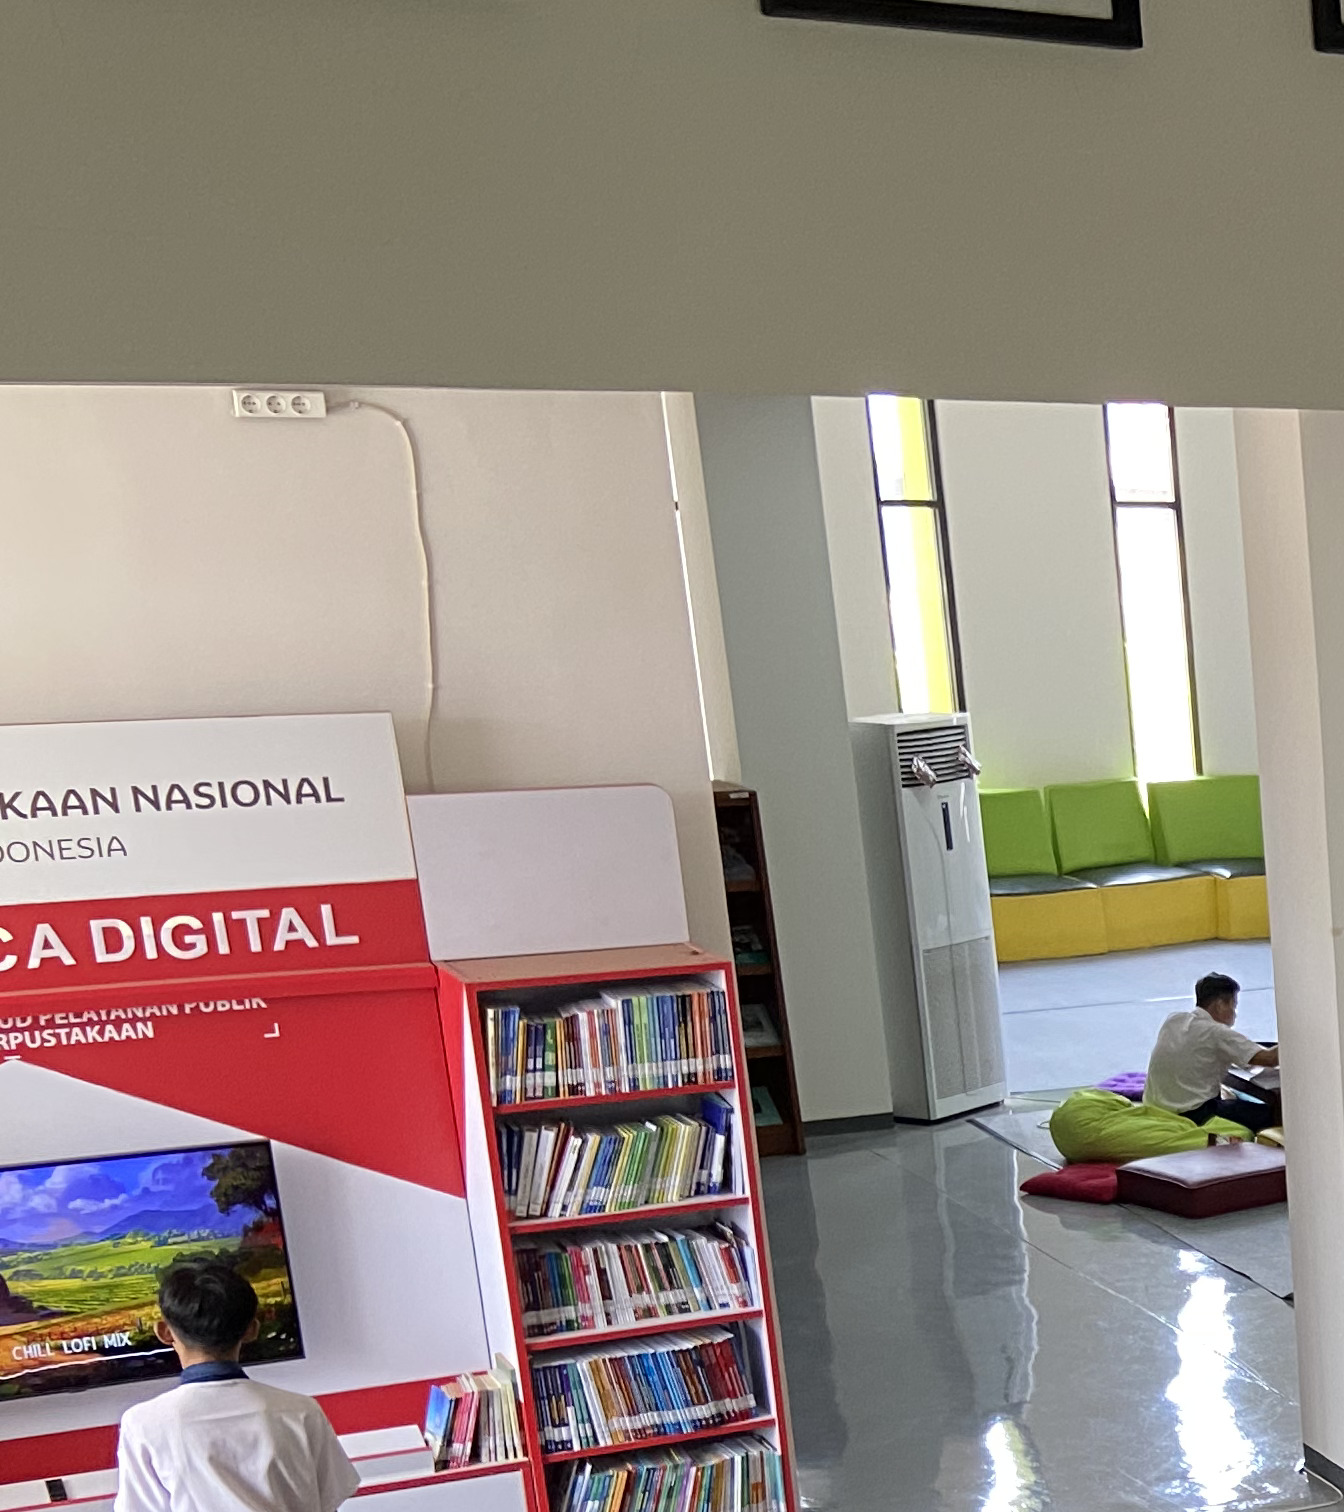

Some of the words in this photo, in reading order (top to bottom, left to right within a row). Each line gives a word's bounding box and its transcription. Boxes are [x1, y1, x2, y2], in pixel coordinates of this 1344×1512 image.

[131, 776, 345, 813] NASIONAL
[0, 836, 128, 863] ONESIA
[90, 904, 359, 963] DIGITAL
[12, 1343, 55, 1361] CHILL
[62, 1336, 97, 1354] LOFI
[103, 1331, 132, 1349] MIX
